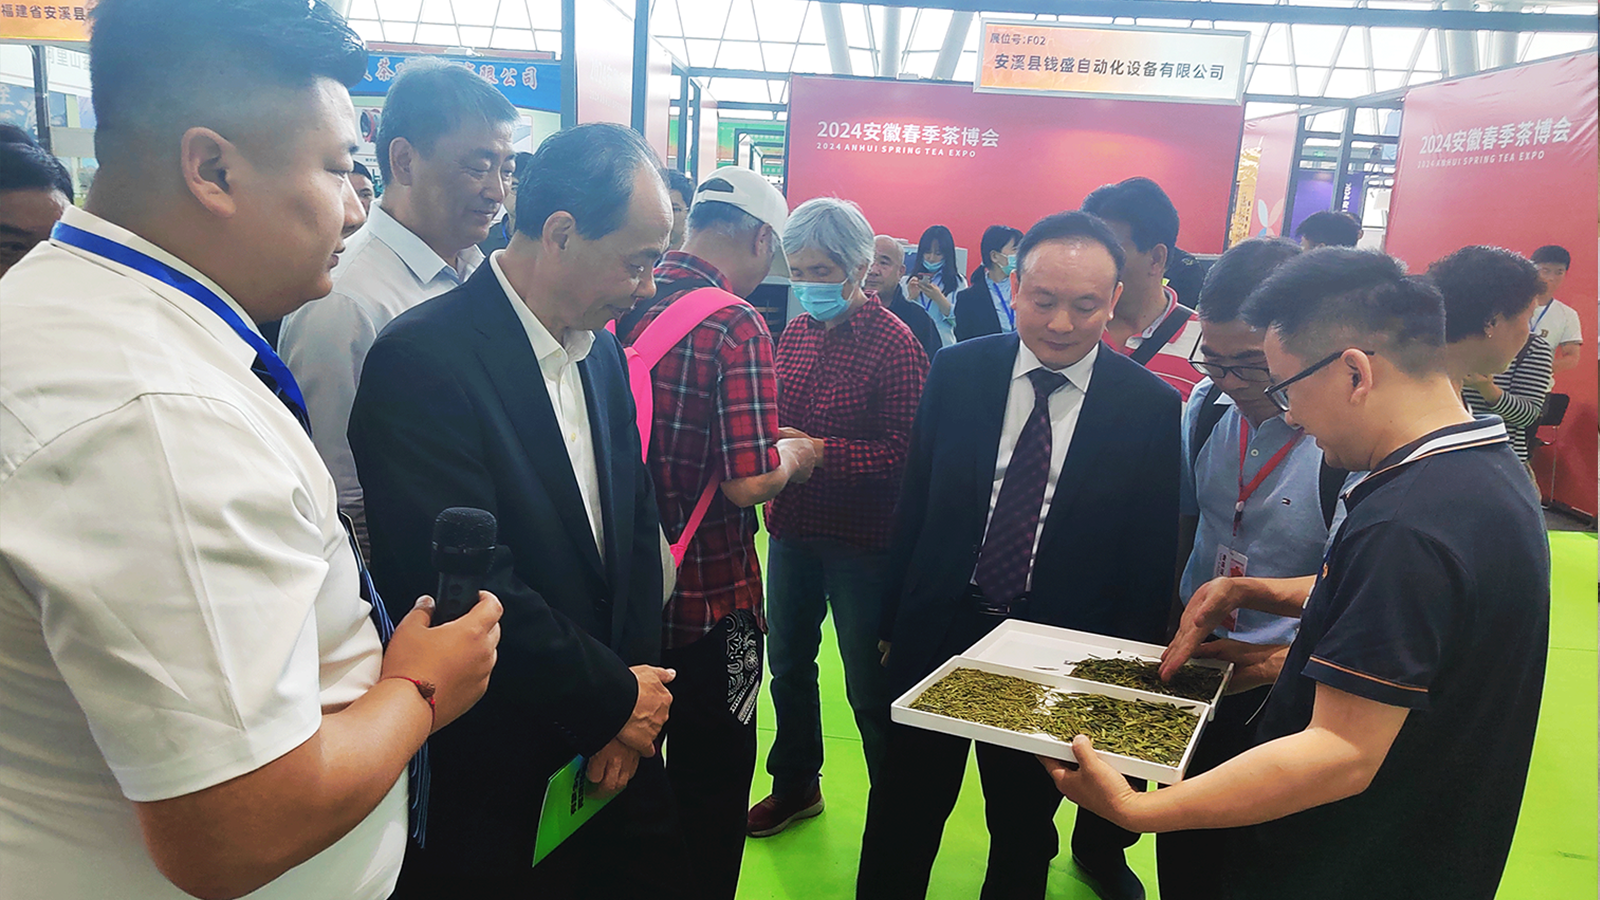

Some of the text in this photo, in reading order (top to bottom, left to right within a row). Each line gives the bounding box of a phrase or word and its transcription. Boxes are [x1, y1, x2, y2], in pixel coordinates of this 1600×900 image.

[1, 4, 86, 21] 福建省安溪县
[990, 33, 1046, 46] 展位号:F02
[994, 53, 1225, 81] 安溪县钱盛自动化设备有限公司
[817, 121, 1000, 148] 2024安徽春季茶博会
[1419, 116, 1572, 155] 2024安徽春季茶博会
[817, 142, 976, 158] 2024 ANHUI SPRING TEA EXPO
[1417, 150, 1545, 169] 2024 ANHUI SPRING TEA EXPO
